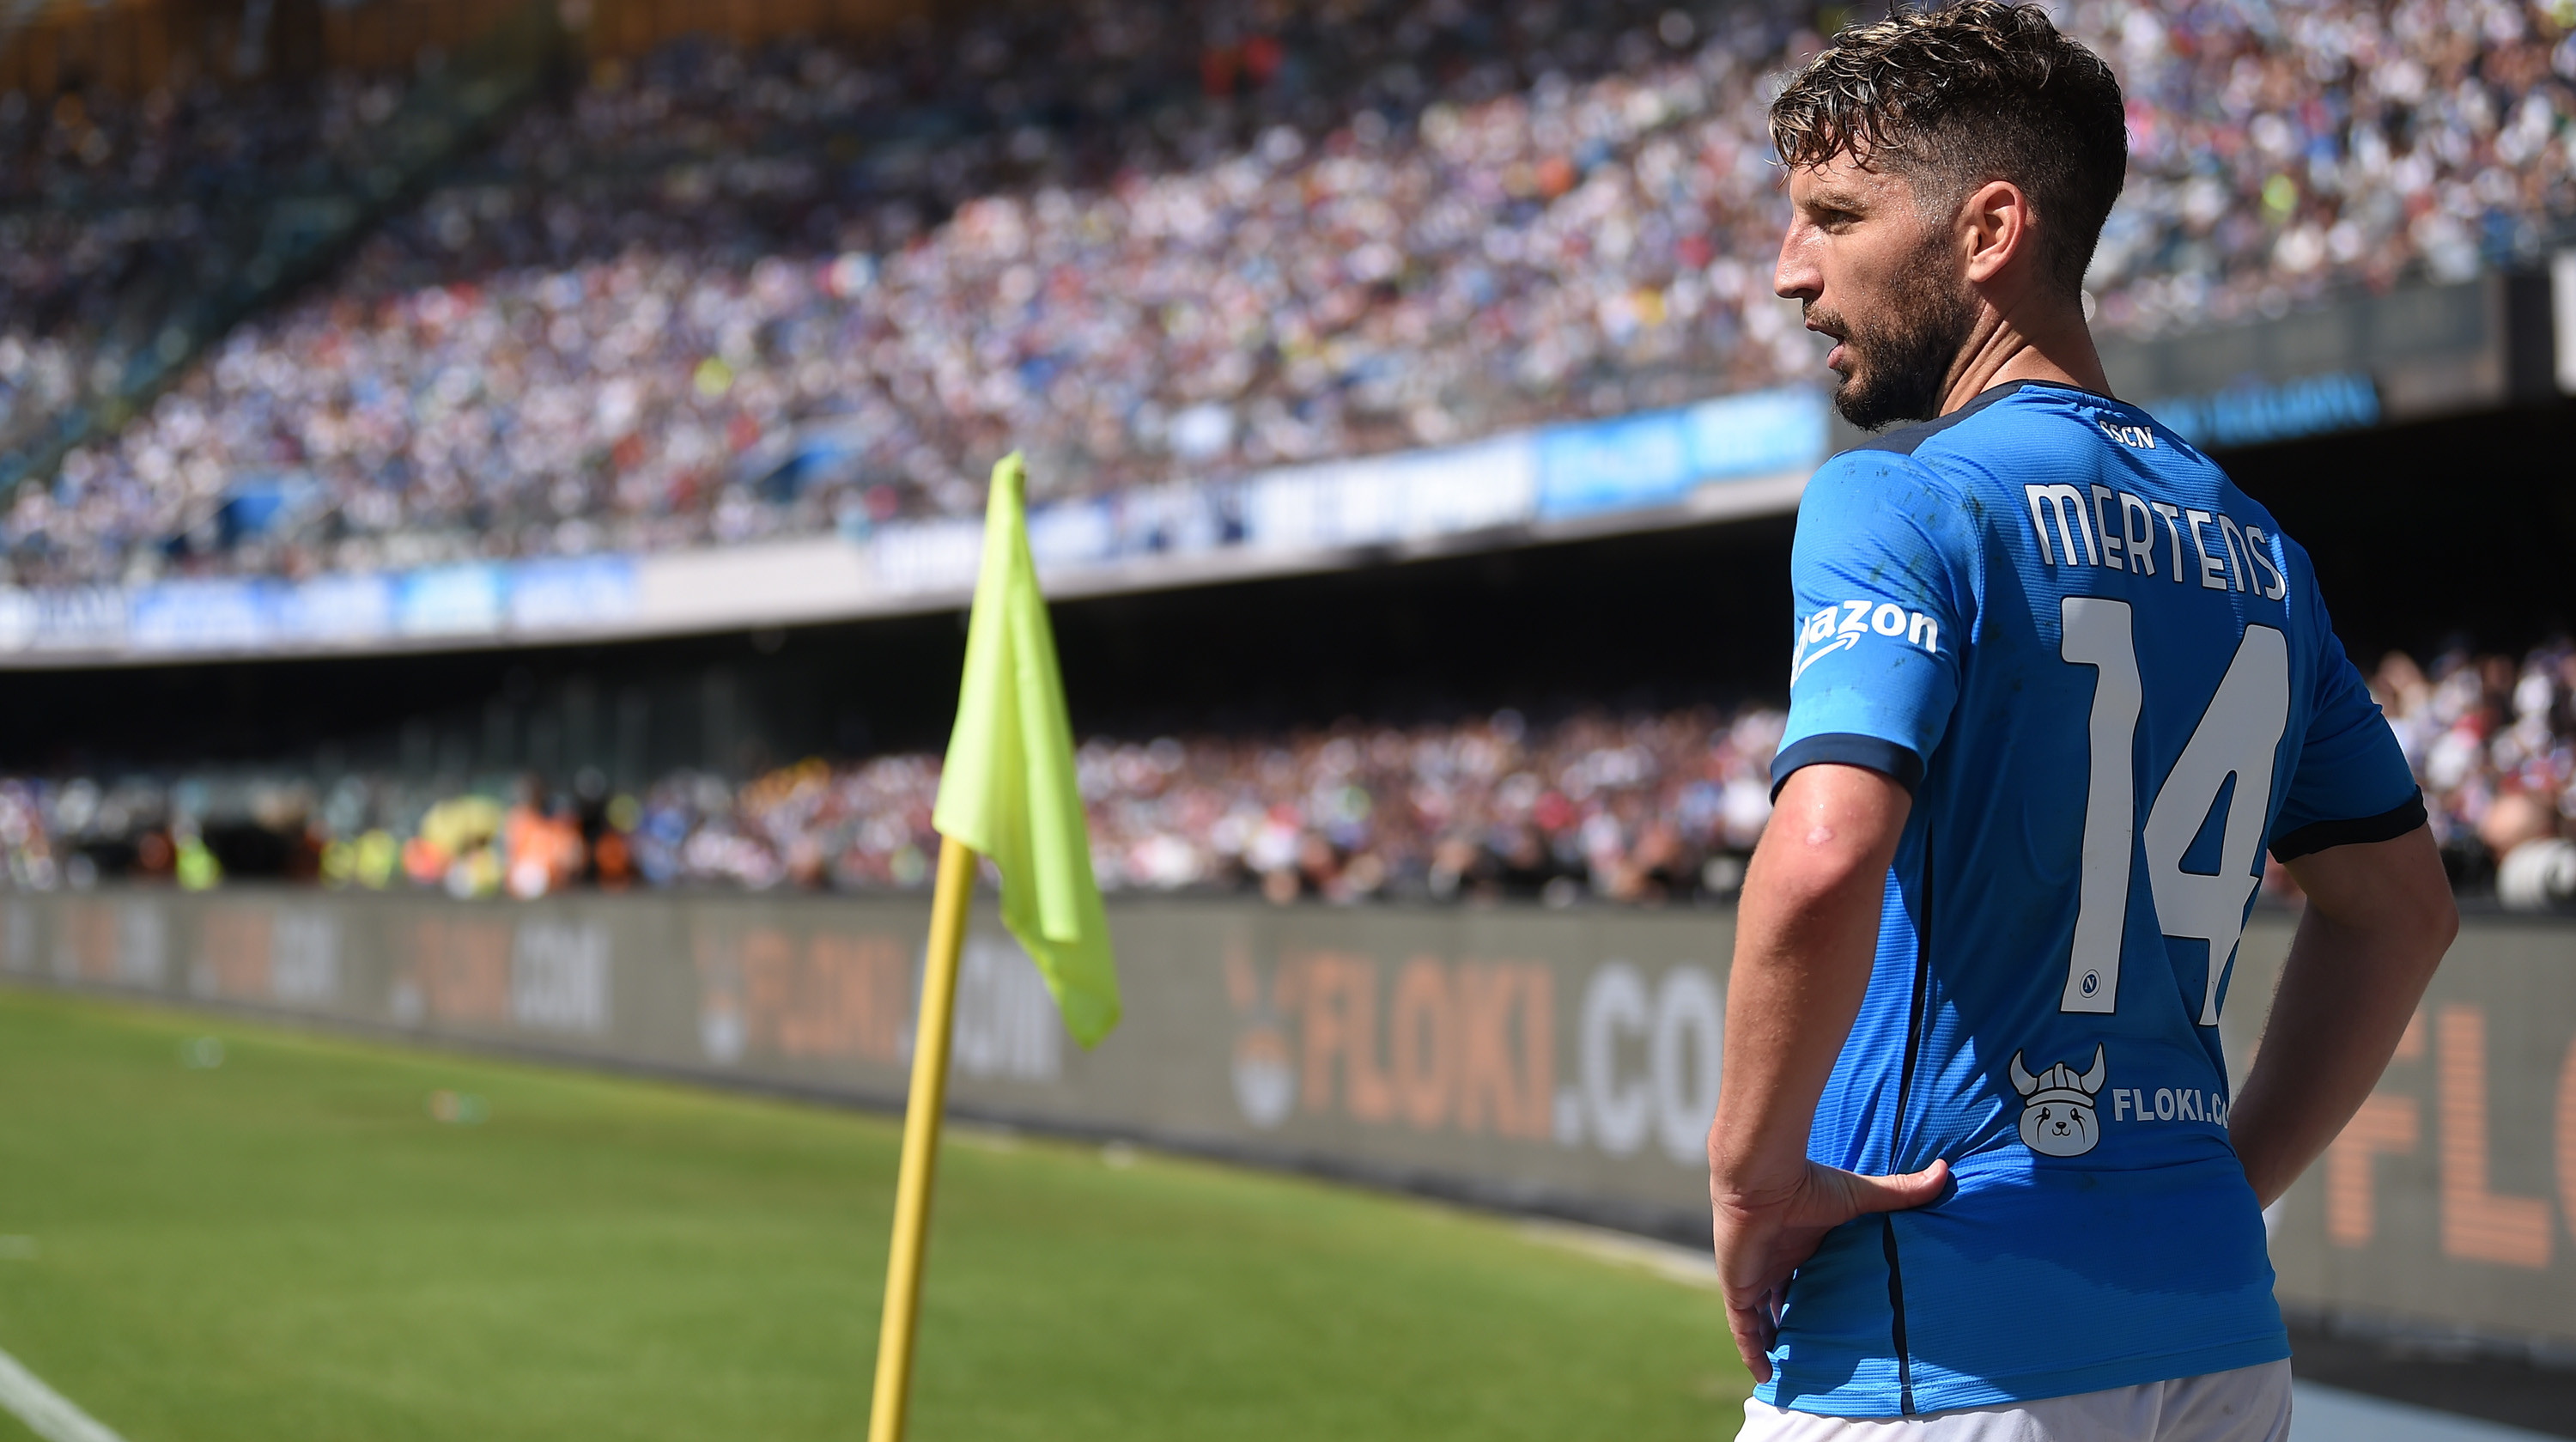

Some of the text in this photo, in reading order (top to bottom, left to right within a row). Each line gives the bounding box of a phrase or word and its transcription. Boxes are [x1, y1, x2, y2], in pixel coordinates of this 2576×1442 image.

[2099, 420, 2156, 449] SSCN
[2024, 483, 2288, 601] MERTENS
[2060, 596, 2291, 1027] 14
[2327, 1001, 2576, 1269] FL
